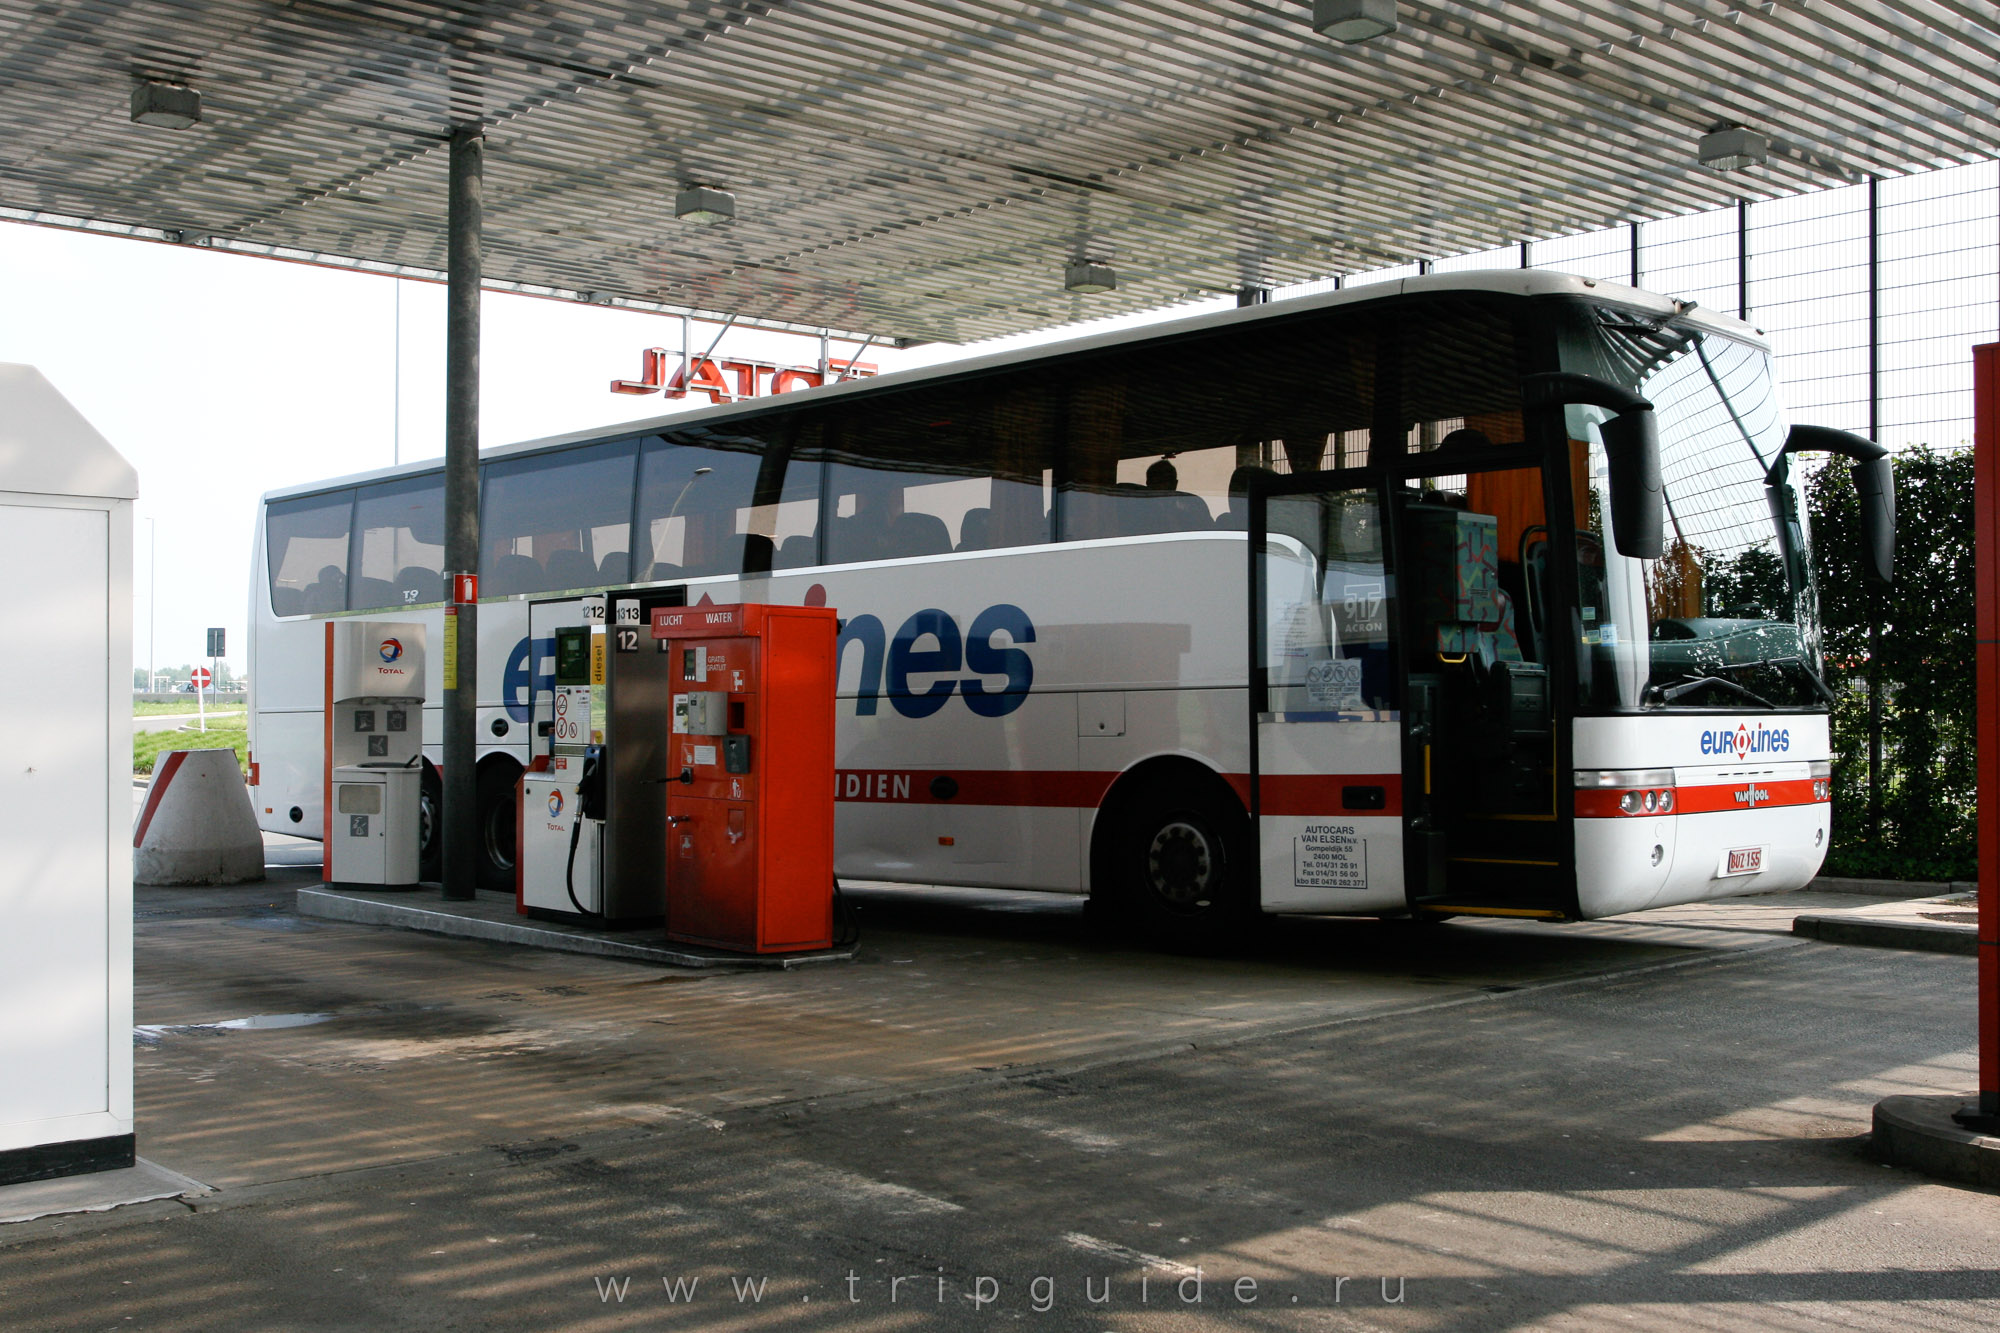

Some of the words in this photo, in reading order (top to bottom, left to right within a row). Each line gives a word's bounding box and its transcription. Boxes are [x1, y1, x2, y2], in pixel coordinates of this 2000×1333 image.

[591, 606, 605, 618] 12
[626, 608, 639, 620] 13
[660, 614, 683, 626] LUCHT
[705, 612, 732, 624] WATER
[1345, 623, 1383, 632] ACRON
[618, 631, 638, 650] 12
[594, 645, 602, 681] diesel
[1305, 826, 1355, 834] AUTOCARS
[1301, 835, 1317, 843] VAN
[1320, 835, 1347, 844] ELSEN
